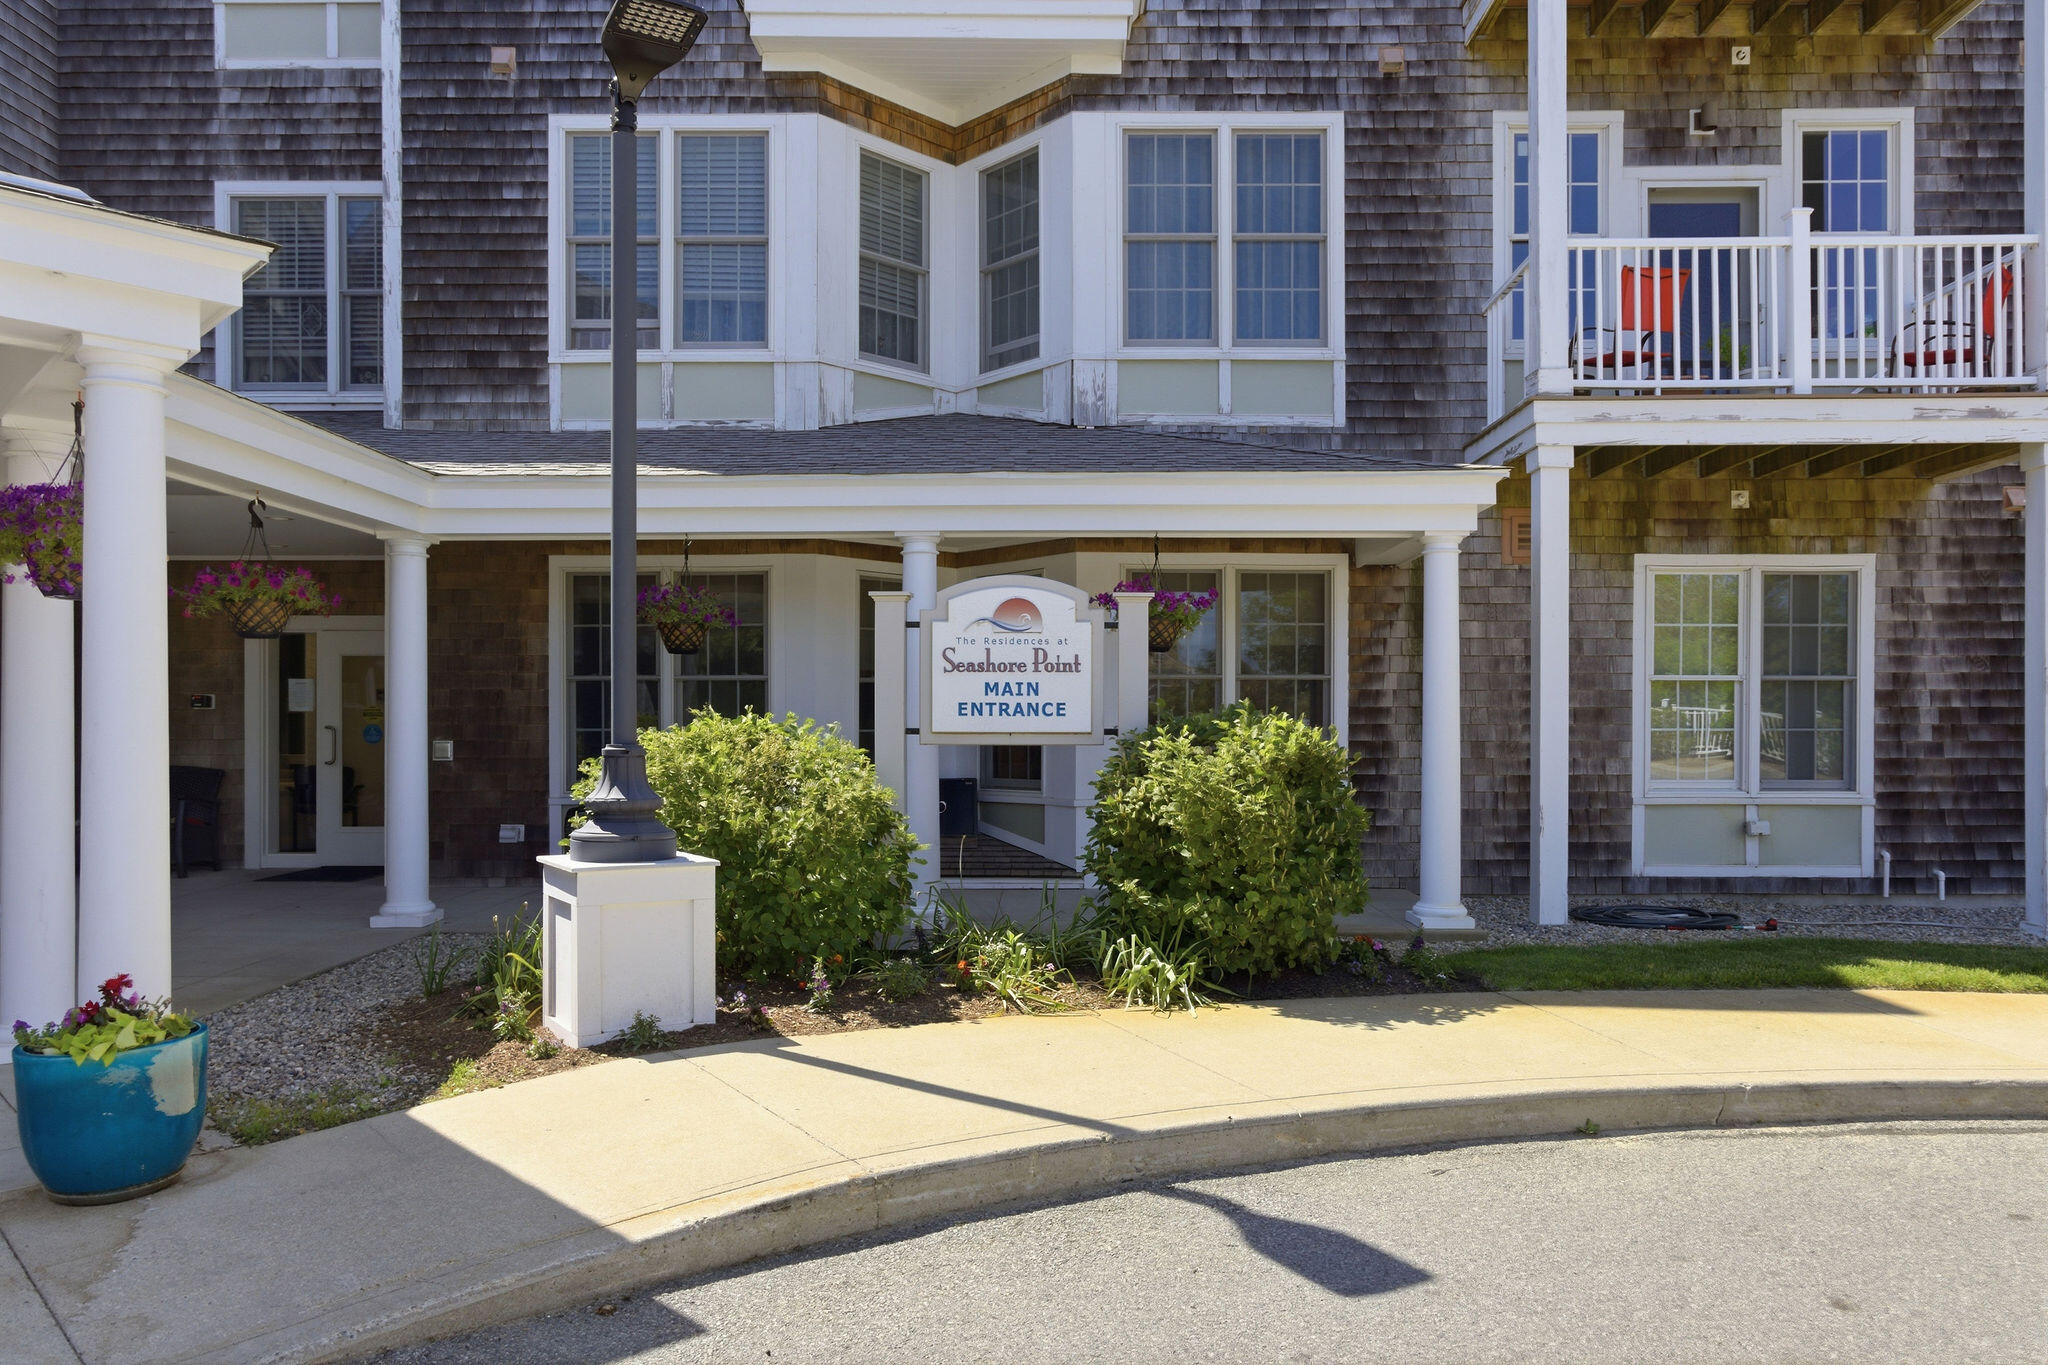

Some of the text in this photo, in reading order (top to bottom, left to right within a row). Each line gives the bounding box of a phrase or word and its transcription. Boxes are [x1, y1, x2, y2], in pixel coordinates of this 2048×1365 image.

[956, 636, 1069, 646] The Residences at
[942, 647, 1082, 674] Seashore Point
[984, 681, 1040, 697] MAIN
[957, 701, 1067, 717] ENTRANCE
